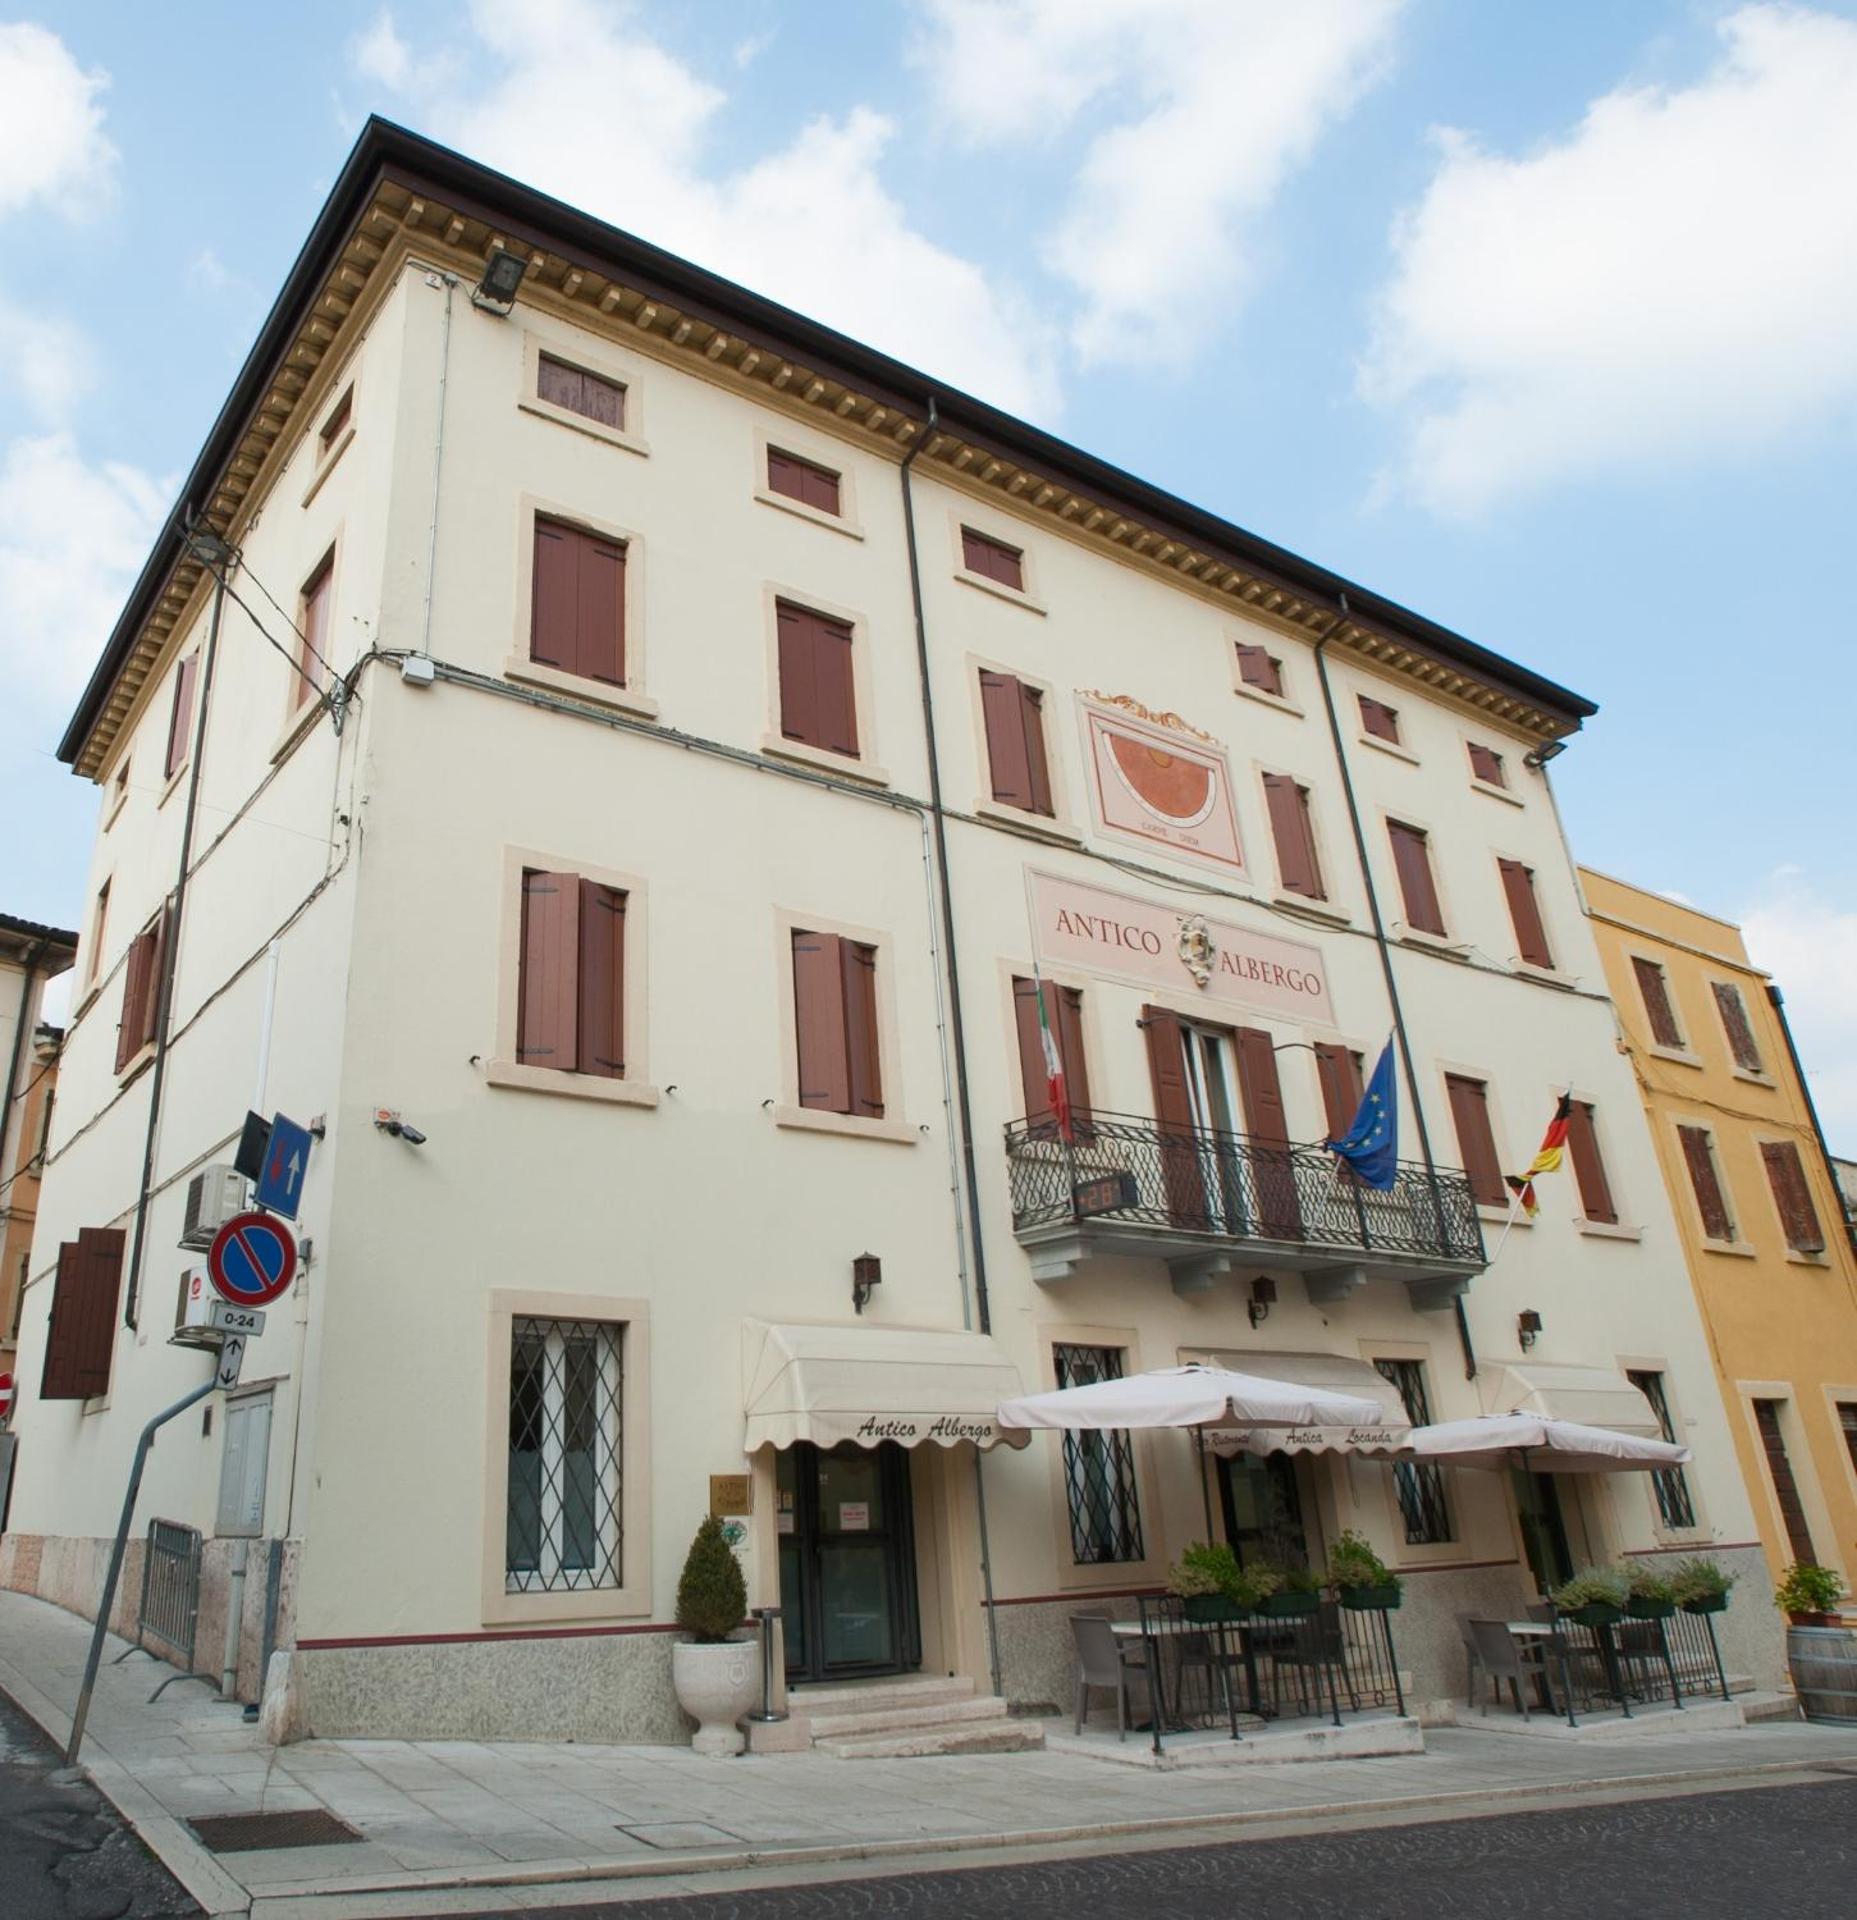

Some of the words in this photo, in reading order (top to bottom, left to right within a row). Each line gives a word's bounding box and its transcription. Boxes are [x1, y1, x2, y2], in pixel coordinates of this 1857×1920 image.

[1055, 909, 1162, 956] ANTICO
[1221, 951, 1321, 996] ALBERGO
[224, 1312, 255, 1328] 0-24
[857, 1415, 917, 1438] Antico
[927, 1416, 992, 1444] Albergo
[1285, 1428, 1324, 1446] Antica
[1345, 1428, 1393, 1445] Locanda
